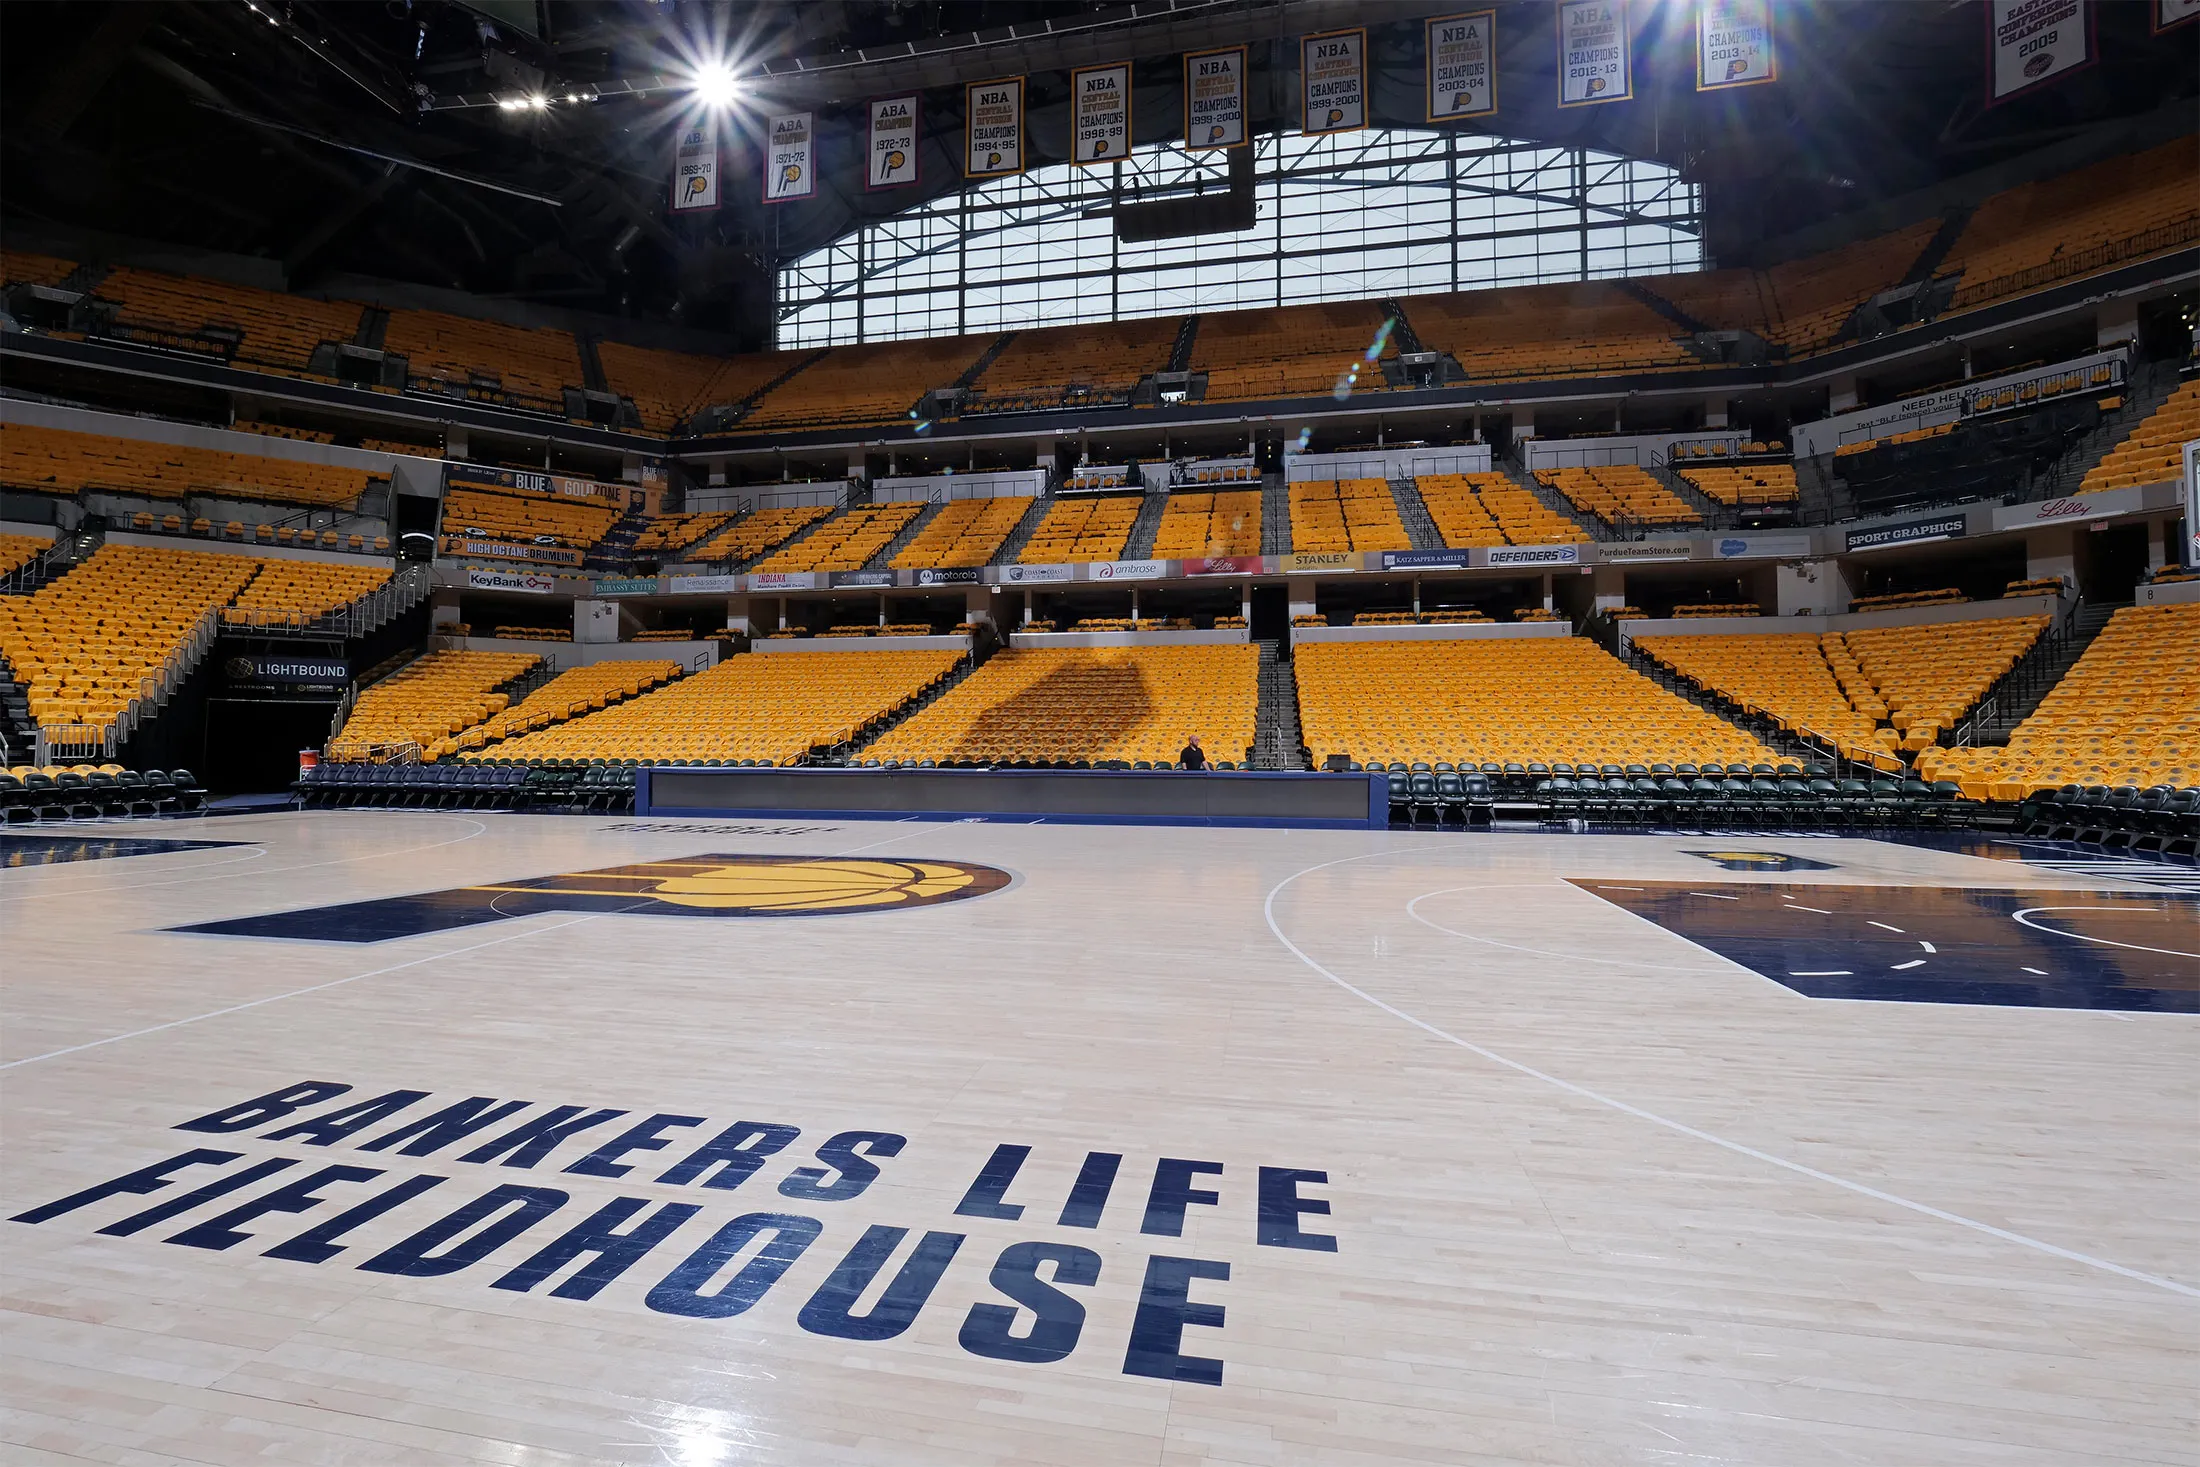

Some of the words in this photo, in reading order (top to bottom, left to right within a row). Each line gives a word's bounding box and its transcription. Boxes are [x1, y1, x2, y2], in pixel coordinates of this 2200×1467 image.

[1573, 7, 1612, 25] NBA
[1998, 0, 2081, 37] CONFERENC
[2001, 5, 2077, 47] CHAMPIONS
[1442, 27, 1478, 42] NBA
[1708, 27, 1762, 47] CHAMPIONS
[1317, 43, 1350, 58] NBA
[2019, 31, 2057, 58] 2009
[1438, 51, 1483, 65] DIVISION
[1569, 47, 1618, 65] CHAMPIONS
[1199, 60, 1231, 75] NBA
[1437, 62, 1484, 80] CHAMPIONS
[1086, 78, 1116, 92] NBA
[1311, 79, 1357, 98] CHAMPIONS
[1438, 77, 1484, 92] 2003-04
[980, 92, 1009, 105] NBA
[1193, 96, 1238, 113] CHAMPIONS
[1308, 94, 1360, 110] 1999-2000
[880, 104, 907, 118] ABA
[1191, 111, 1240, 125] 1999-2000
[777, 119, 804, 133] ABA
[976, 114, 1013, 125] DIVISION
[1080, 112, 1123, 128] CHAMPIONS
[684, 131, 709, 145] ABA
[974, 125, 1016, 139] CHAMPIONS
[1080, 126, 1123, 140] 1998-99
[876, 137, 910, 150] 1972-73
[974, 140, 1015, 151] 1994-95
[775, 151, 805, 165] 1971-72
[680, 163, 712, 176] 1969-70
[1901, 398, 1935, 412] NEED
[1857, 420, 1874, 429] Text
[1899, 407, 1932, 420] (space)
[516, 474, 545, 491] BLUE
[2036, 499, 2092, 519] Lilly
[1848, 530, 1890, 546] SPORT
[1892, 519, 1963, 540] GRAPHICS
[467, 542, 490, 554] HIGH
[492, 544, 529, 558] OCTANE
[529, 548, 577, 562] DRUMLINE
[1490, 550, 1558, 563] DEFENDERS
[1599, 546, 1690, 557] PurdueTeamStore.com
[1209, 559, 1236, 572] Lilly
[1295, 554, 1348, 565] STANLEY
[1396, 556, 1412, 564] KATZ
[1413, 555, 1435, 563] SAPPER
[1443, 554, 1466, 563] MILLER
[934, 569, 977, 581] motorola
[1116, 563, 1157, 575] ambrose
[471, 574, 524, 588] KeyBank
[758, 574, 786, 583] INDIANA
[596, 583, 628, 592] EMBASSY
[630, 582, 657, 590] SUITES
[2147, 589, 2154, 601] 8
[2043, 598, 2048, 610] 7
[170, 1080, 907, 1201] BANKERS
[953, 1143, 1338, 1252] LIFE
[6, 1148, 1231, 1386] FIELDHOUSE
